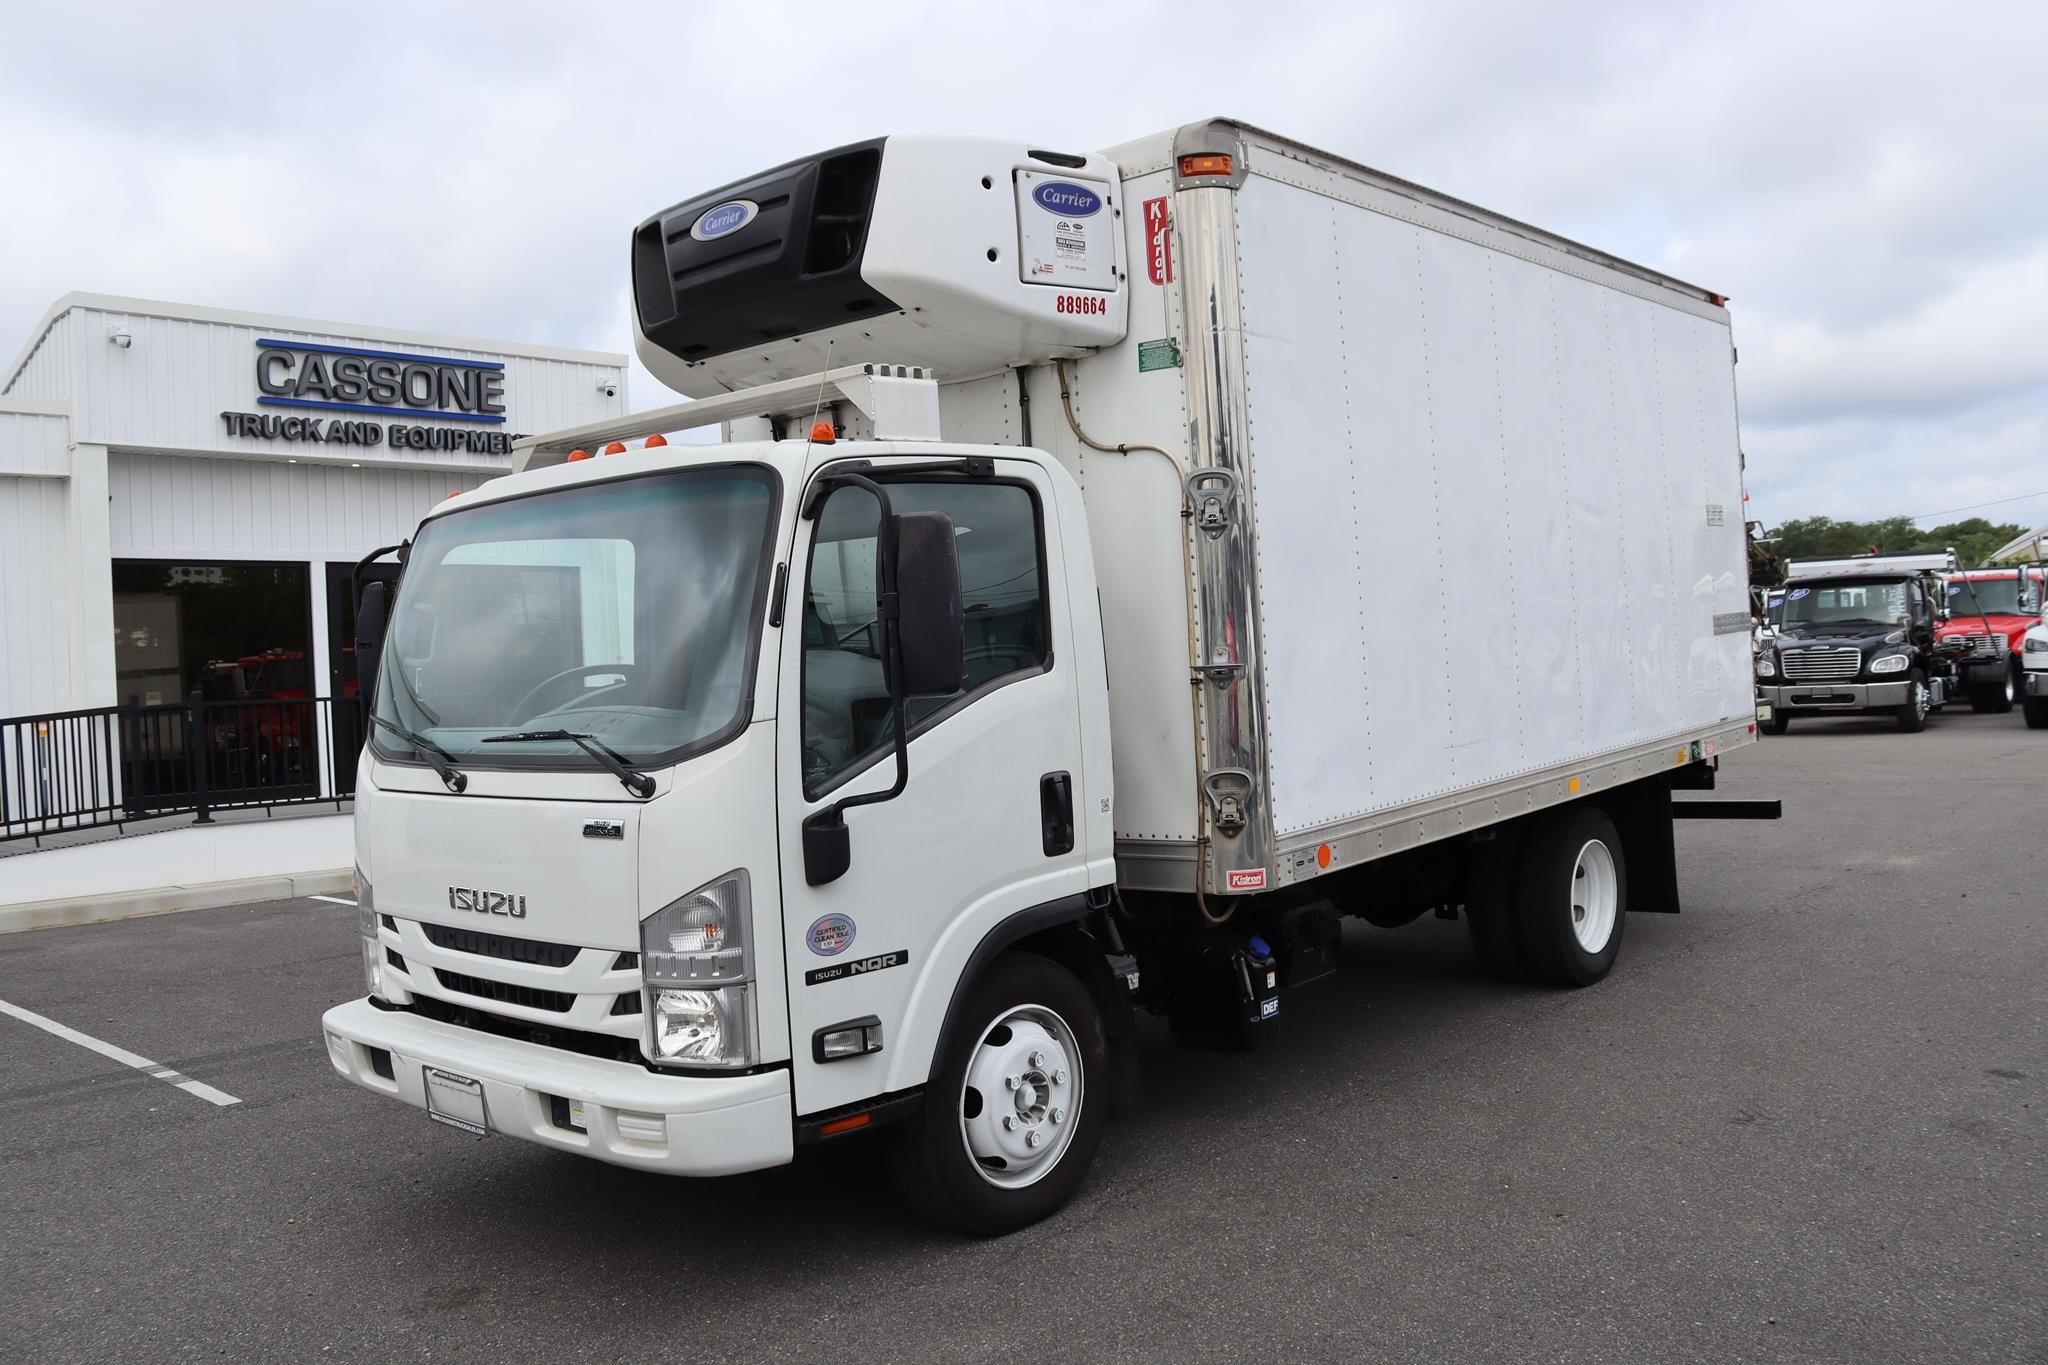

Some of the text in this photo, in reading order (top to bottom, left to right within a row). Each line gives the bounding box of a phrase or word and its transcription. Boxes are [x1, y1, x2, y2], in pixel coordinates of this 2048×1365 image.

[1042, 188, 1093, 208] Carrier
[705, 211, 741, 231] Carrier
[1056, 295, 1106, 315] 889664
[257, 348, 506, 414] CASSONE
[221, 411, 535, 455] TRUCK AND EQUIPMEN
[1232, 874, 1262, 886] Kidron
[449, 885, 526, 919] ISUZU
[814, 930, 850, 943] CLEAN IDLE
[816, 925, 847, 936] CERTIFIED
[815, 954, 897, 980] ISUZU NQR
[1263, 999, 1278, 1016] DEF
